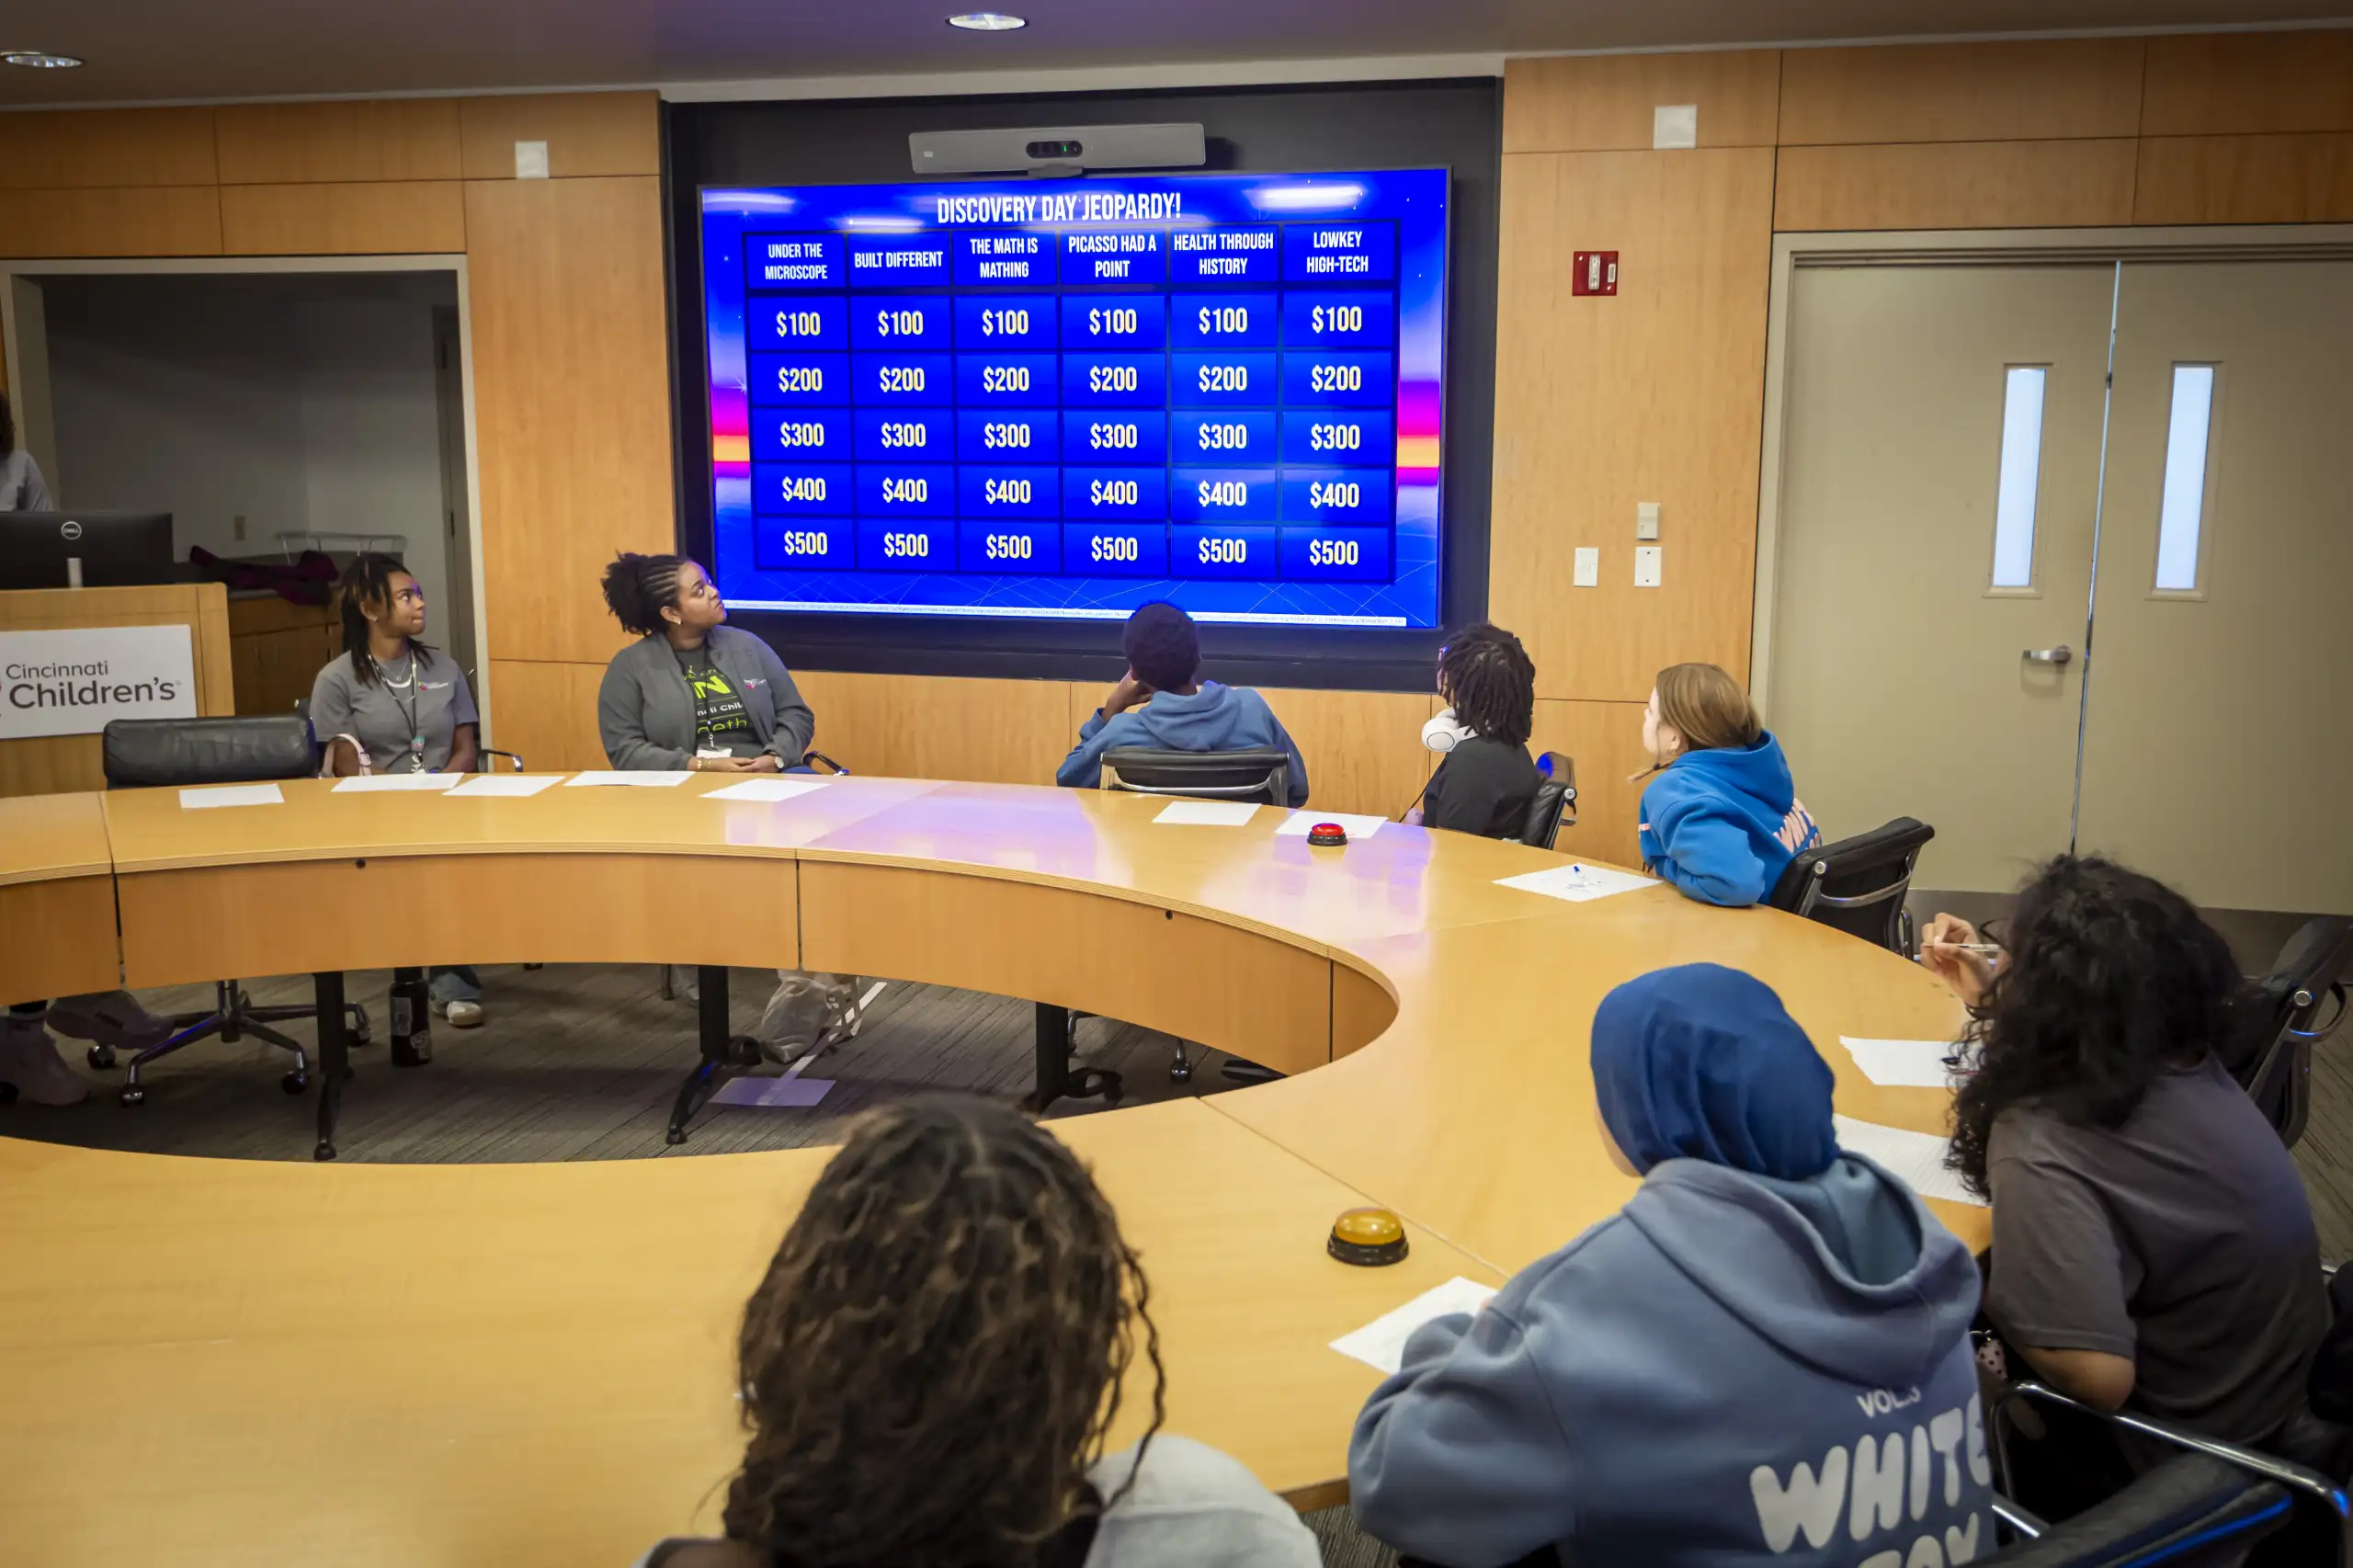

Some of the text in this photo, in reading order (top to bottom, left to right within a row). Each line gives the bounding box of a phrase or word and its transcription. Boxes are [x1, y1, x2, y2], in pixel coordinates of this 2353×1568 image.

[937, 191, 1182, 224] DISCOVERY DAY JEOPARDY!
[767, 243, 824, 259] UNDER THE
[970, 237, 1039, 255] THE MATH IS
[1068, 233, 1157, 254] PICASSO HAD A
[1174, 233, 1274, 251] HEALTH THROUGH
[1313, 231, 1363, 248] LOWKEY
[765, 265, 828, 280] MICROSCOPE
[854, 251, 944, 269] BUILT DIFFERENT
[980, 261, 1029, 278] MATHING
[1095, 260, 1131, 278] POINT
[1199, 257, 1248, 275] HISTORY
[1306, 256, 1369, 273] HIGH-TECH
[776, 311, 821, 337] $100
[878, 310, 924, 337] $100
[982, 309, 1029, 336] $100
[1089, 308, 1137, 335] $100
[1199, 306, 1248, 335] $100
[1312, 305, 1362, 334] $100
[778, 367, 823, 393] $200
[880, 366, 925, 393] $200
[983, 366, 1029, 393] $200
[1089, 365, 1137, 393] $200
[1199, 365, 1247, 392] $200
[1311, 364, 1361, 392] $200
[779, 421, 824, 448] $300
[881, 422, 926, 449] $300
[983, 422, 1030, 449] $300
[1090, 422, 1138, 449] $300
[1199, 422, 1247, 450] $300
[1311, 423, 1360, 451] $300
[781, 476, 826, 502] $400
[882, 477, 927, 504] $400
[985, 478, 1031, 505] $400
[1090, 479, 1138, 506] $400
[1198, 480, 1247, 507] $400
[1310, 481, 1359, 509] $400
[784, 530, 828, 556] $500
[883, 531, 928, 558] $500
[986, 533, 1032, 560] $500
[1091, 535, 1138, 562] $500
[1198, 537, 1246, 564] $500
[1309, 539, 1358, 566] $500
[6, 660, 108, 680] Cincinnati
[9, 676, 176, 710] Children's
